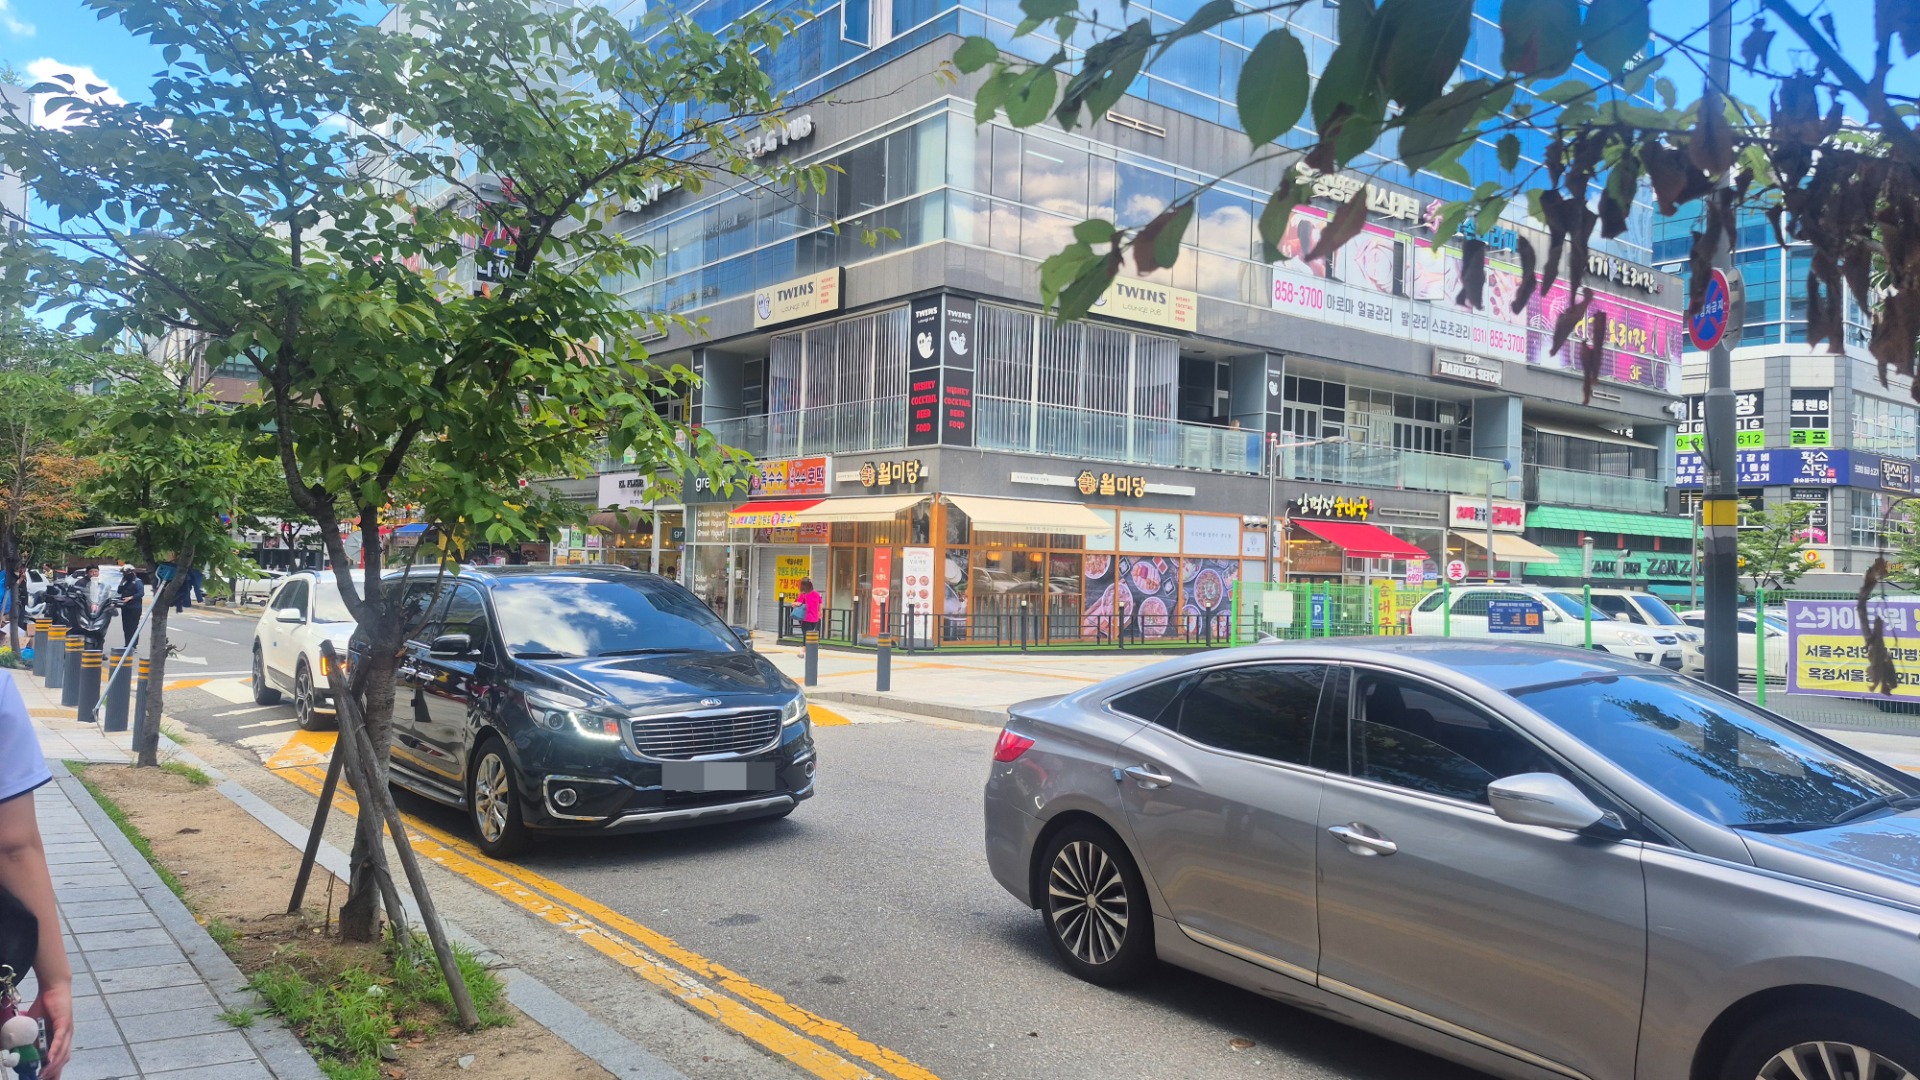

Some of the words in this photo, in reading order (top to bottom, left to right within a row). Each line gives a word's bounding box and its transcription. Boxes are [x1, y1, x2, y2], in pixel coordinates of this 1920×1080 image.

[782, 114, 811, 146] PUB
[777, 281, 814, 302] TWINS
[1116, 283, 1167, 305] TWINS
[915, 306, 938, 318] TWINS
[947, 309, 972, 320] TWINS
[1122, 304, 1148, 314] LOUNGE
[1150, 308, 1162, 316] PUB
[1275, 279, 1323, 310] 858-3700
[1326, 294, 1355, 314] 아로마
[1357, 300, 1393, 323] 얼굴관리
[1401, 310, 1410, 327] 발
[1412, 313, 1429, 331] 관리
[1432, 317, 1471, 340] 스포츠관리
[1490, 329, 1526, 354] 858-3700
[1440, 361, 1477, 379] BARBER
[1478, 369, 1501, 385] SHOP
[1629, 364, 1642, 381] 3F
[911, 394, 937, 405] COCKTAIL
[944, 397, 971, 407] COCKTAIL
[916, 409, 931, 419] BEER
[949, 409, 965, 418] BEER
[915, 422, 931, 432] FOOD
[948, 420, 965, 429] FOOD
[1792, 430, 1826, 444] 골프
[1801, 451, 1829, 465] 황소
[877, 459, 920, 486] 월미당
[1801, 464, 1829, 477] 식당
[1742, 472, 1770, 483] 소고기
[1099, 472, 1147, 498] 월미당
[673, 530, 683, 539] gr
[1122, 520, 1176, 541] 越米堂
[1450, 563, 1463, 578] 꽃
[1314, 604, 1321, 616] P
